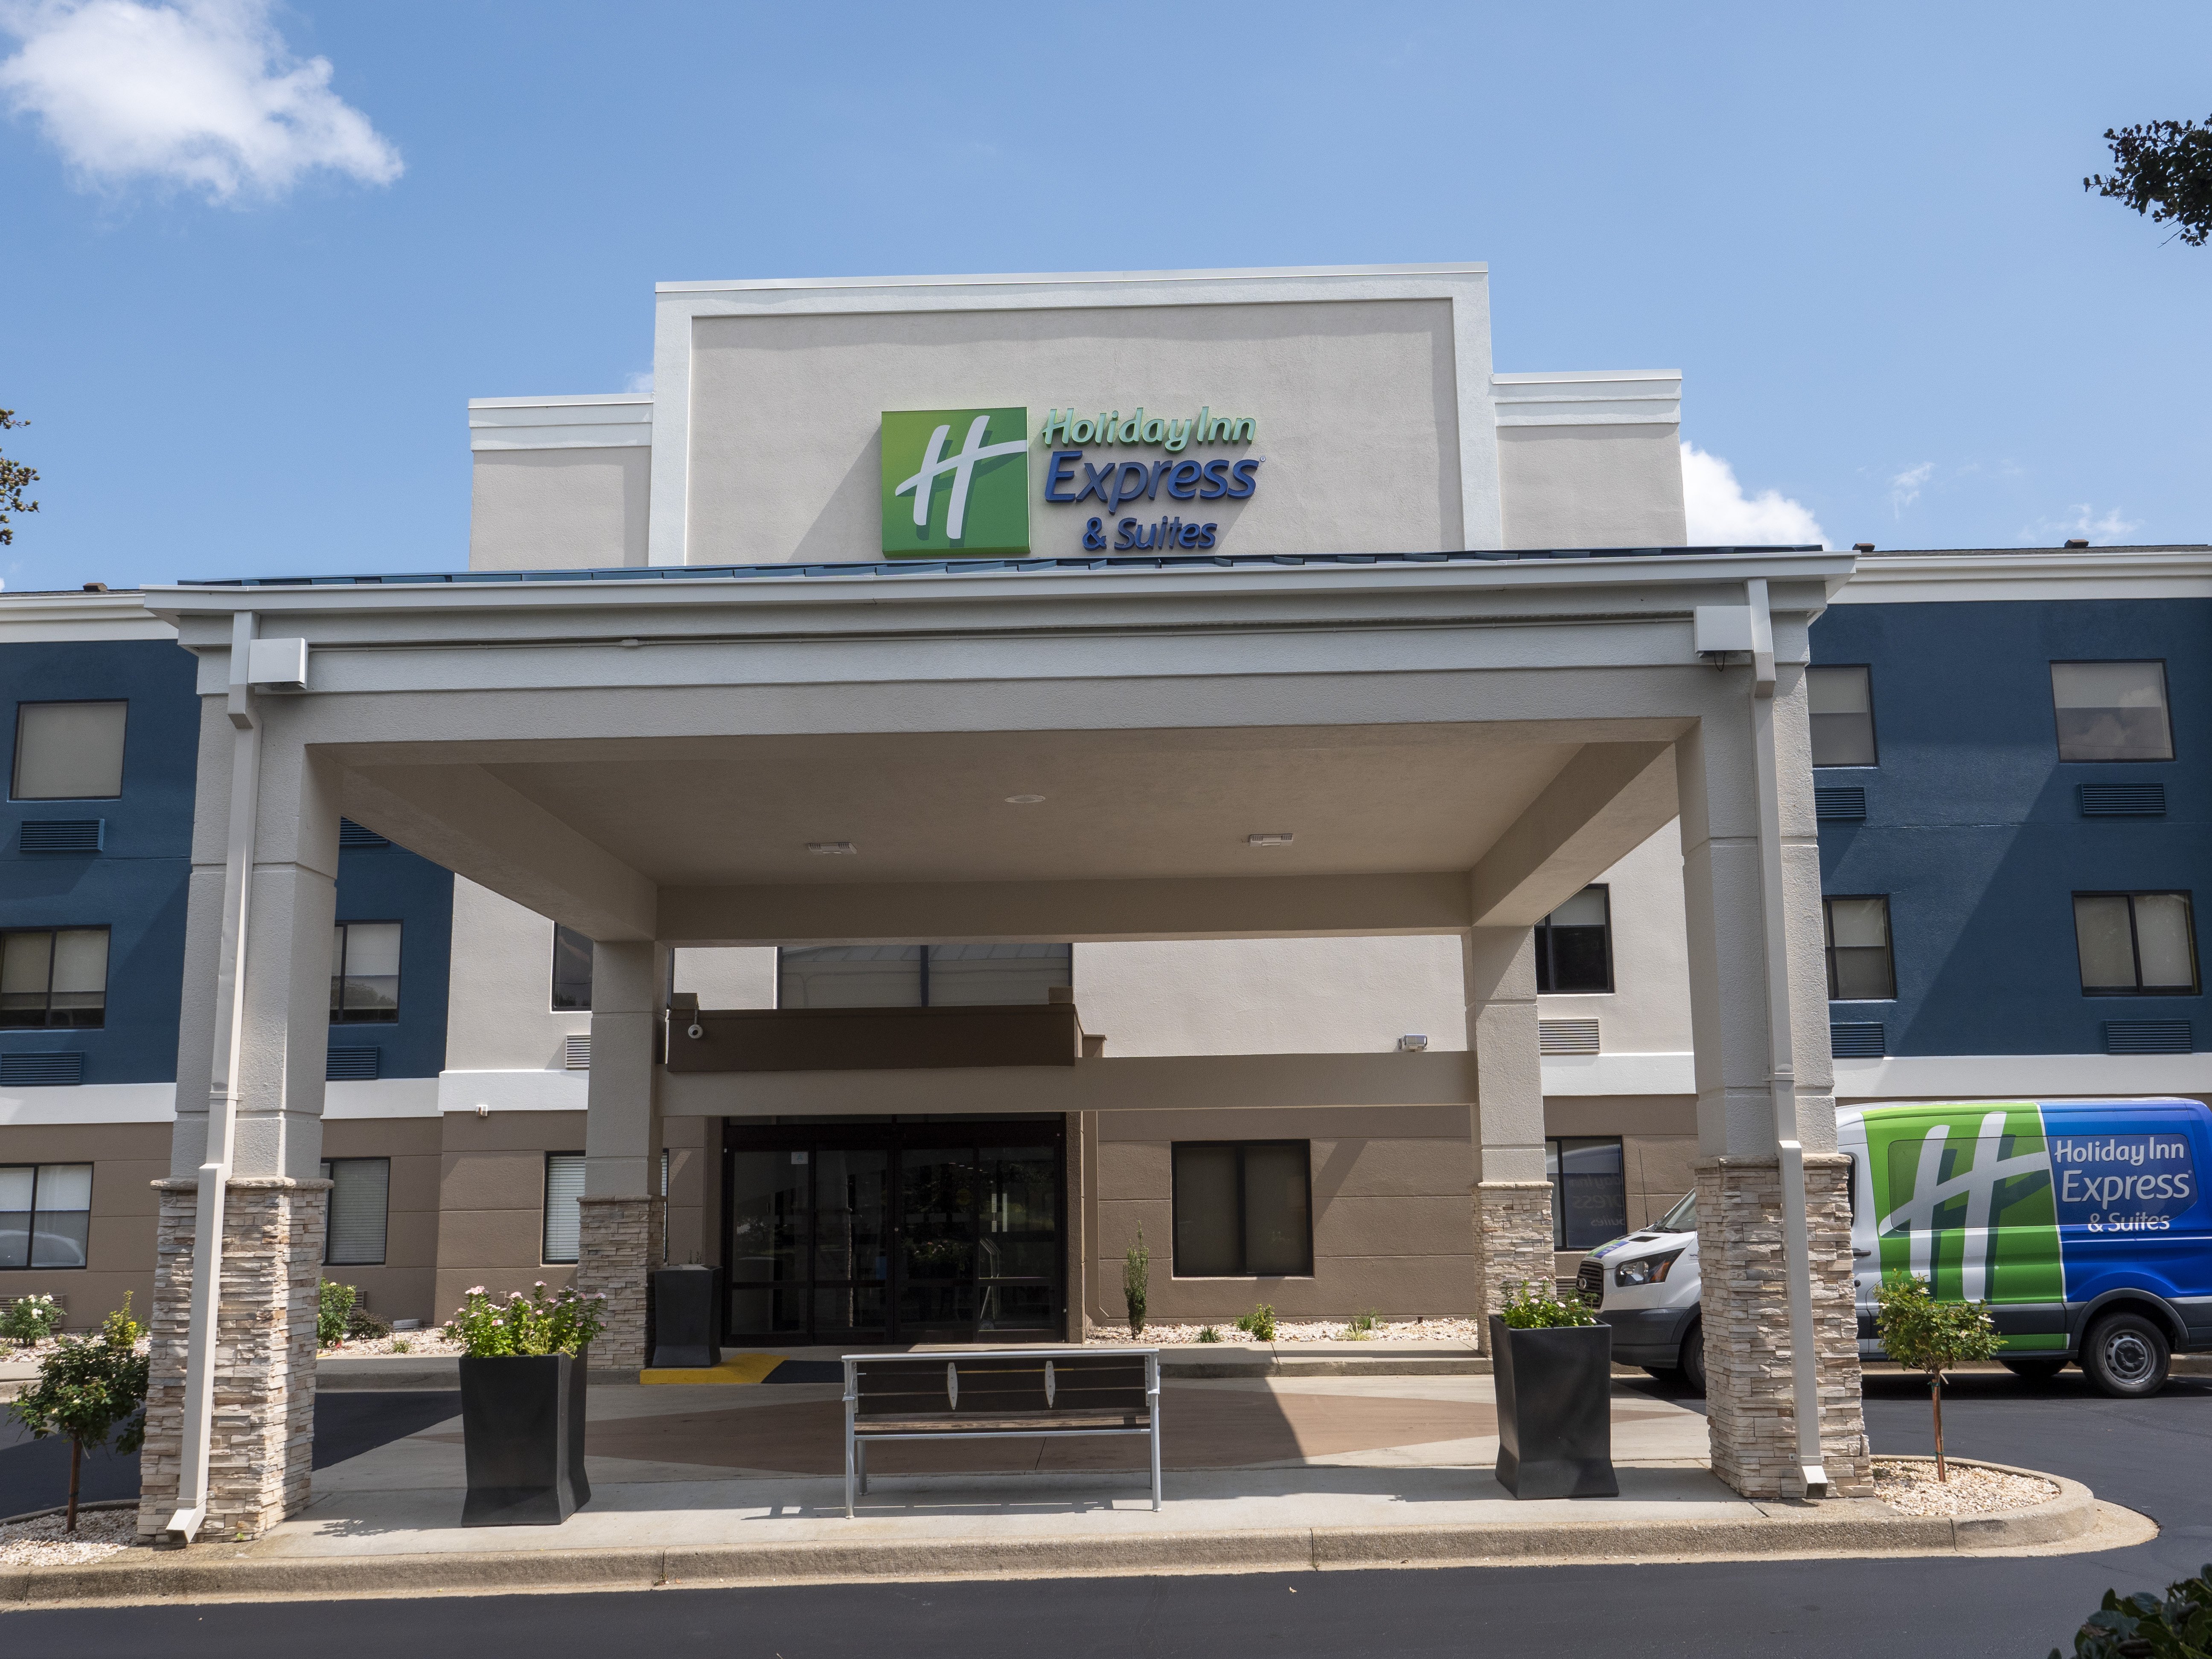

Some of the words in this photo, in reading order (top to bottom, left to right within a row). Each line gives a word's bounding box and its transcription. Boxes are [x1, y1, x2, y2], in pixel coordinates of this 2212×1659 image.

[1042, 407, 1192, 454] Holiday
[1196, 406, 1256, 444] Inn
[1044, 450, 1259, 515] Express
[1082, 517, 1106, 551] &
[1114, 516, 1217, 550] Suites
[2055, 1139, 2145, 1166] Holiday
[2149, 1137, 2185, 1159] Inn
[2062, 1170, 2190, 1210] Express
[2087, 1213, 2104, 1233] &
[2108, 1212, 2171, 1232] Suites
